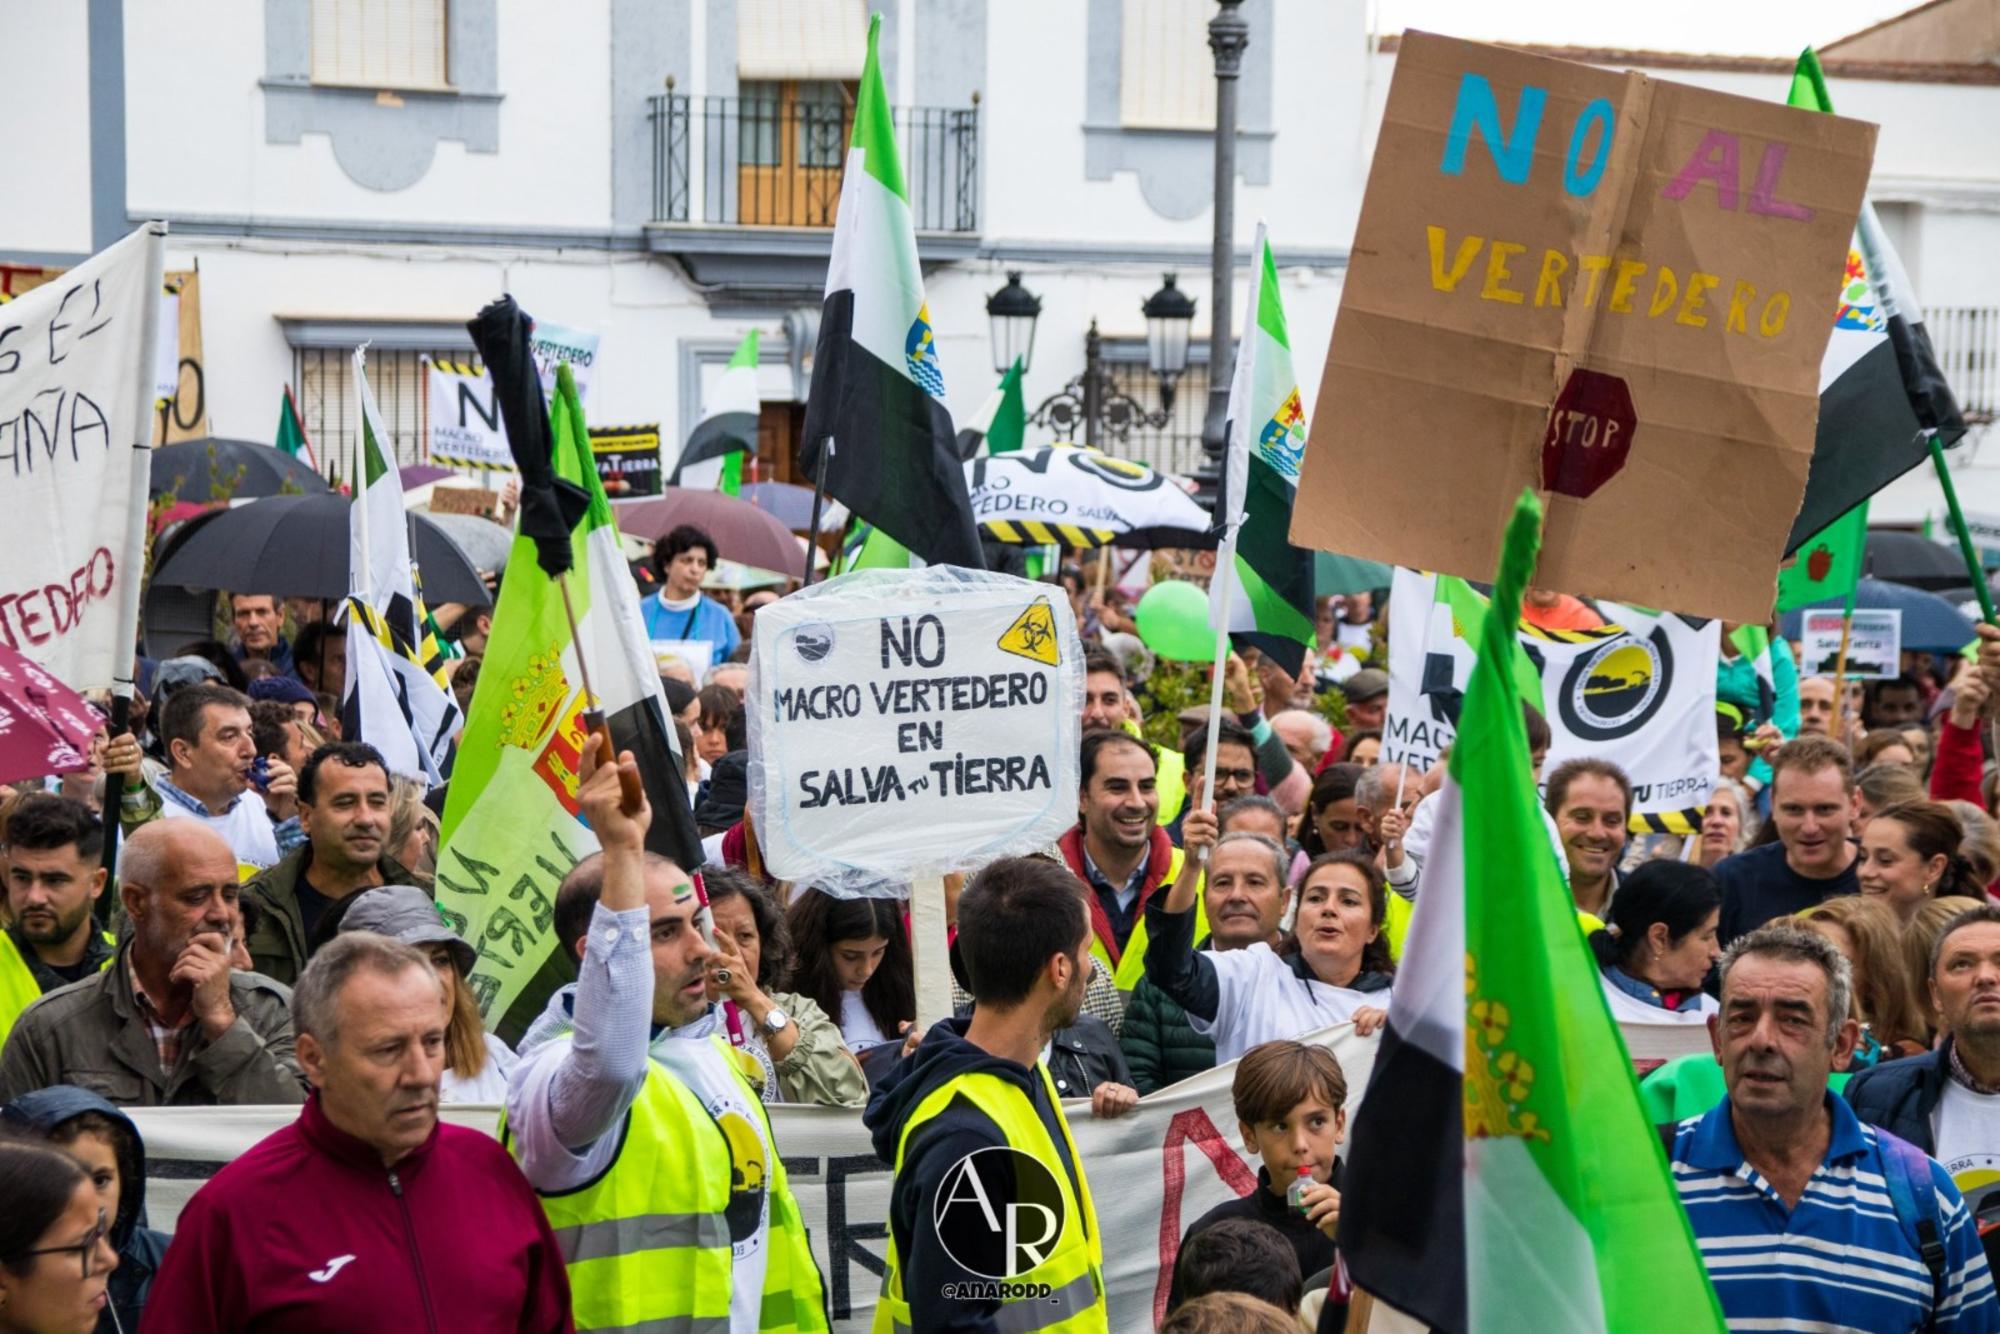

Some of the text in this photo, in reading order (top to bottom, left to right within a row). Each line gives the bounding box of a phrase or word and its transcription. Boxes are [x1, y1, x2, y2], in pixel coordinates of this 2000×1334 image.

[1440, 73, 1816, 223] NO AL
[1426, 225, 1791, 339] VERTEDERO
[1550, 409, 1620, 448] STOP
[880, 614, 946, 669] NO
[774, 671, 1049, 723] MACRO VERTEDERO
[898, 720, 944, 754] EN
[799, 752, 1052, 809] SALVA TU TIERRA
[1655, 777, 1710, 801] TIERRA
